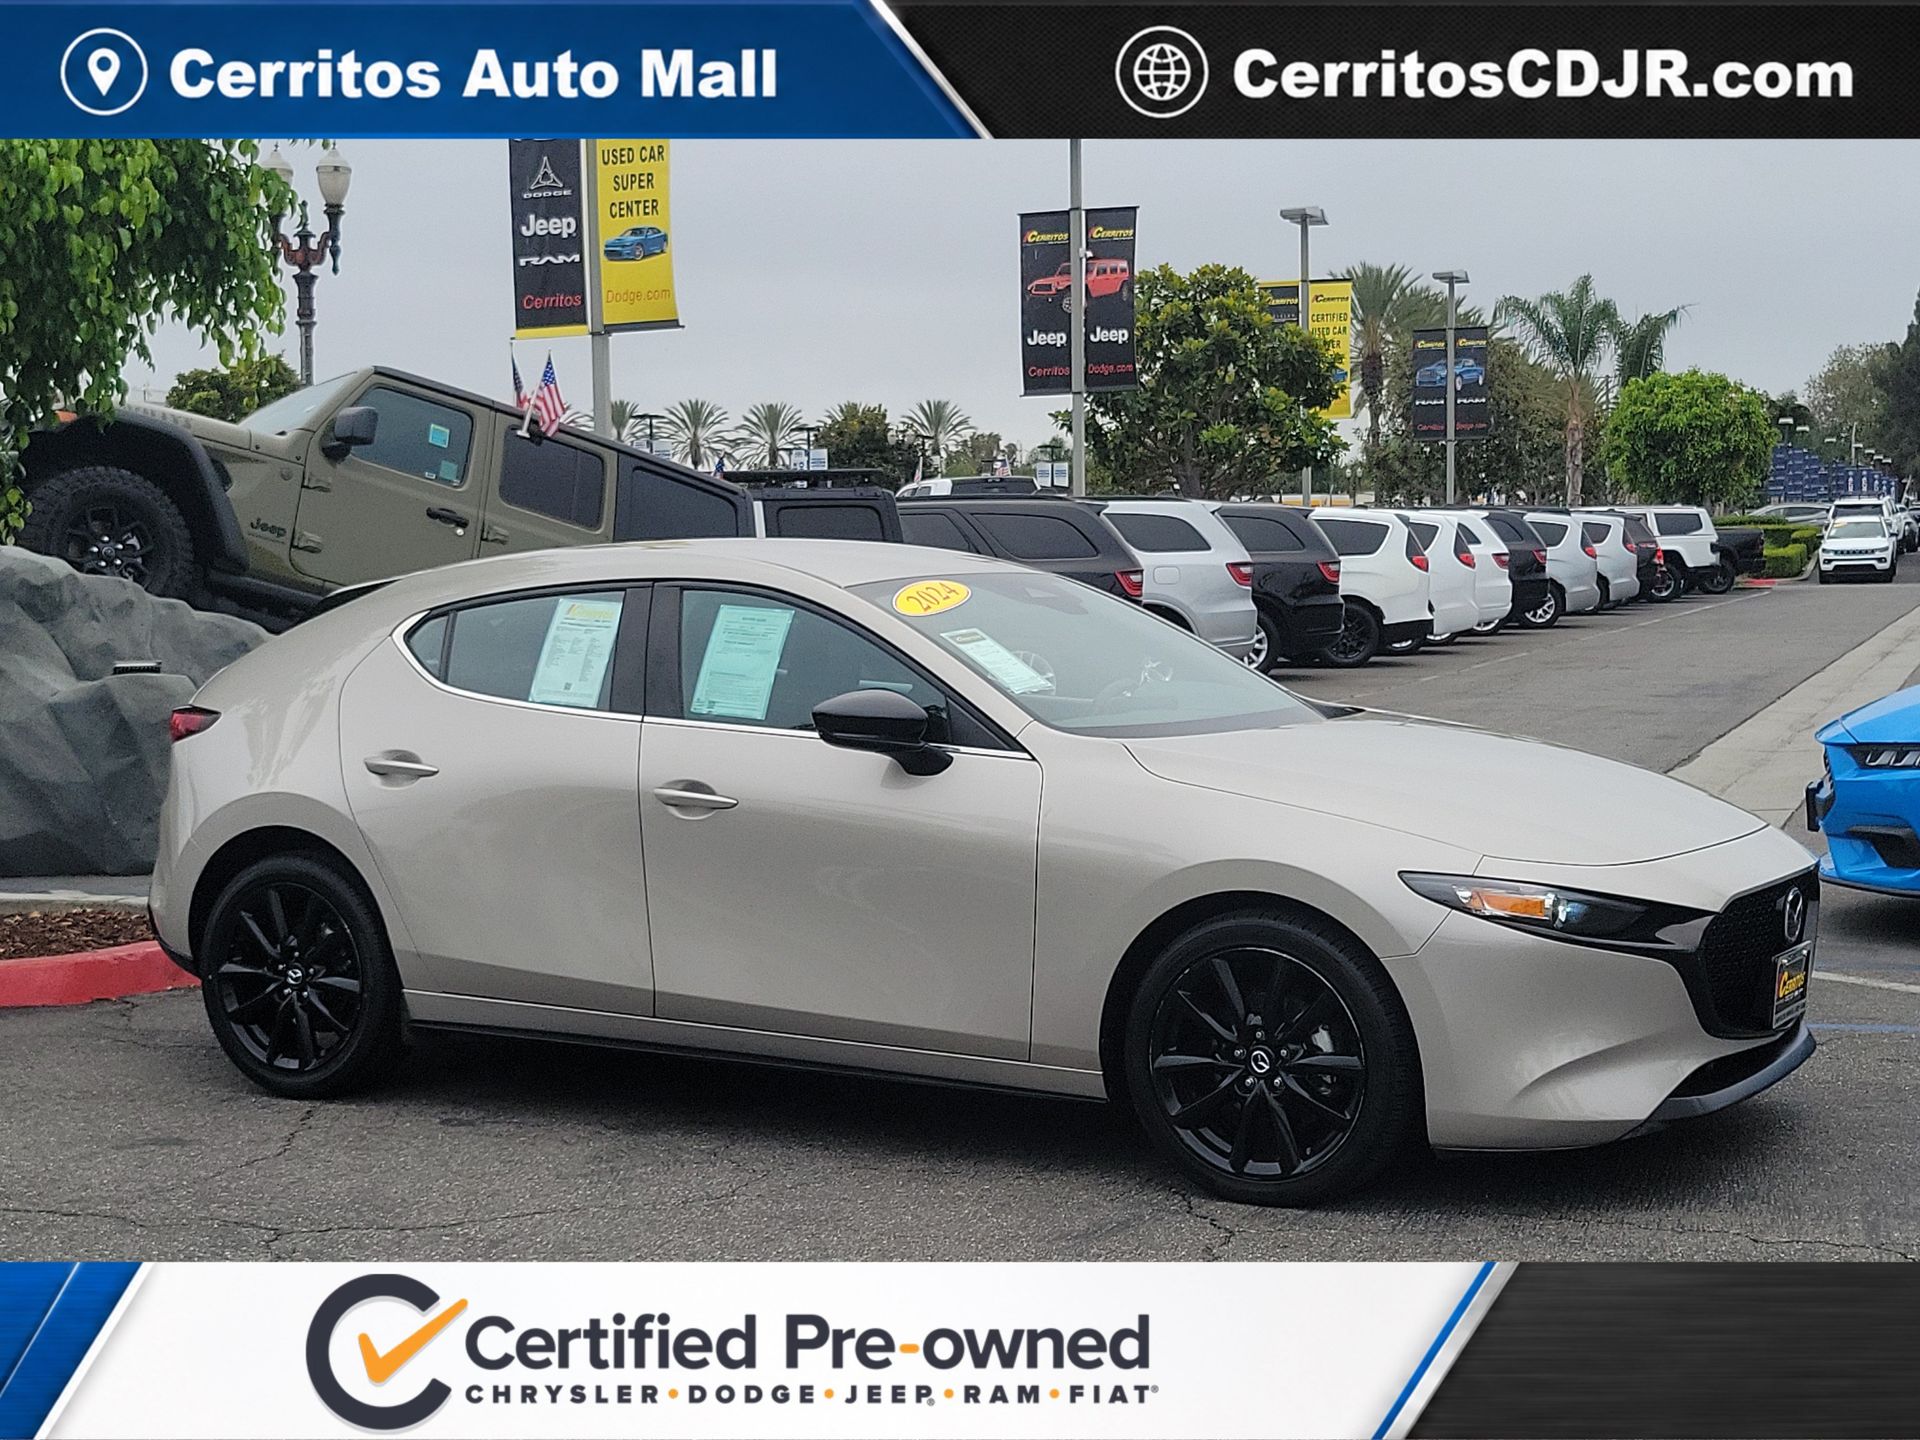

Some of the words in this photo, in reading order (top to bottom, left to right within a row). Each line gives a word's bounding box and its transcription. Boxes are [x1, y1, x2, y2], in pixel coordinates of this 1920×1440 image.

[602, 148, 635, 165] USED
[639, 145, 665, 162] CAR
[613, 172, 655, 191] SUPER
[523, 190, 572, 199] DODGE
[609, 199, 659, 219] CENTER
[521, 214, 578, 238] Jeep
[519, 253, 581, 267] RAM
[523, 294, 582, 310] Cerritos
[606, 288, 671, 305] Dodge.com
[1311, 312, 1348, 323] CERTIFIED
[1027, 330, 1067, 347] Jeep
[1090, 326, 1129, 344] Jeep
[1332, 326, 1347, 336] CAR
[1028, 366, 1070, 378] Cerritos
[250, 517, 287, 538] Jeep
[907, 582, 959, 612] 2024
